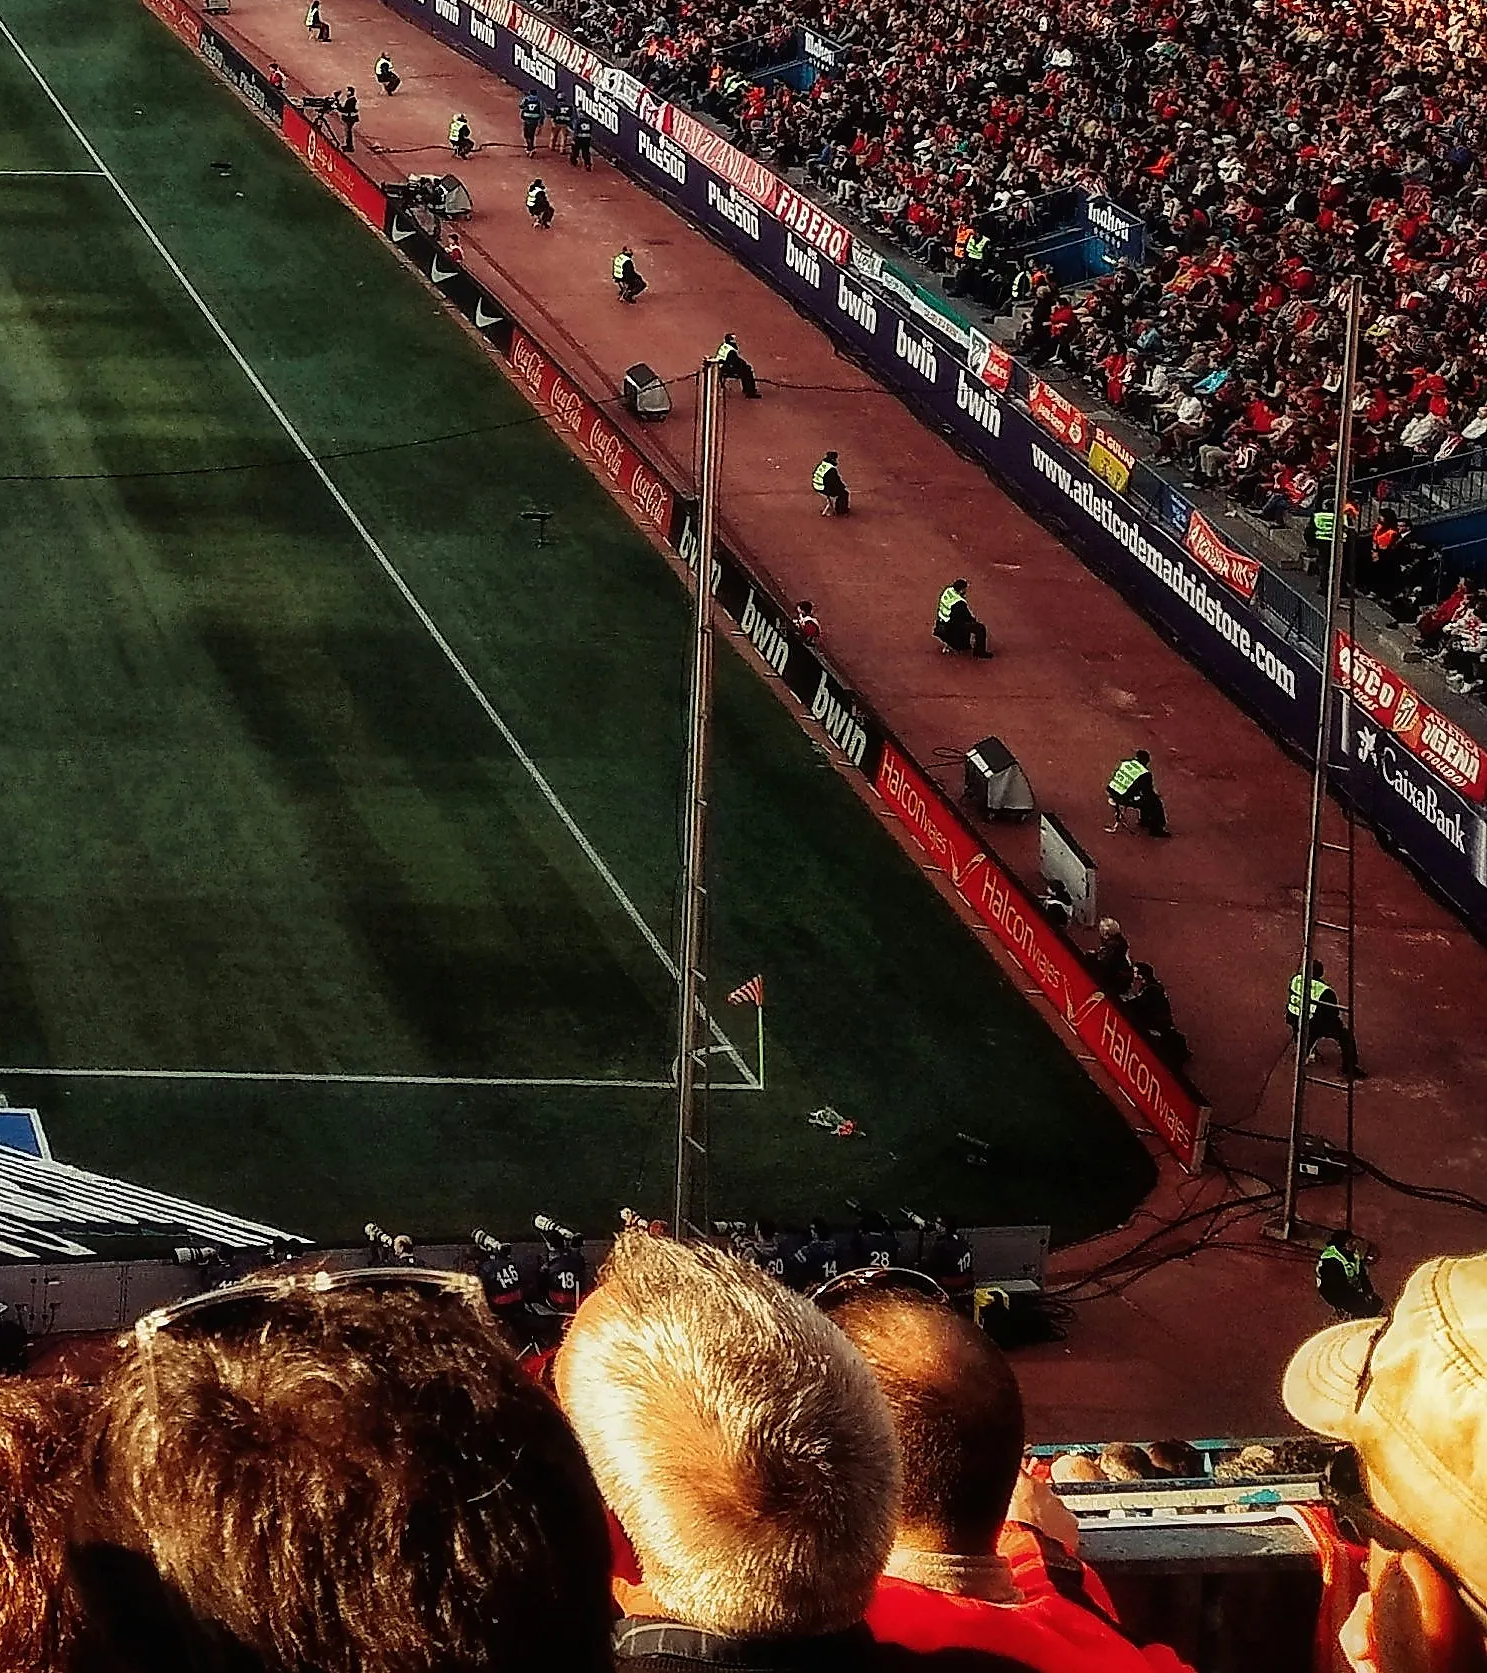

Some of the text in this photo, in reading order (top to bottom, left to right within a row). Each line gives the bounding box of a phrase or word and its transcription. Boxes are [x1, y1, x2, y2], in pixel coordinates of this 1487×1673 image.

[514, 43, 556, 90] Plus500
[575, 85, 618, 134] Plus500
[638, 130, 686, 185] Plus500
[708, 180, 759, 241] Plus500
[776, 189, 842, 259] FABERO
[786, 232, 820, 289] bwin
[838, 274, 877, 335] bwin
[514, 337, 545, 392] Coca-Cola
[896, 320, 937, 384] bwin
[551, 376, 584, 432] Coca-Cola
[956, 369, 1001, 438] bwin
[590, 419, 624, 476] Coca-Cola
[631, 465, 667, 525] Coca-Cola
[1031, 443, 1297, 701] www.atleticodemadridstore.com
[741, 587, 789, 679] bwin
[812, 670, 867, 766] bwin
[1382, 746, 1466, 855] CaixaBank
[496, 1265, 519, 1290] 146
[557, 1271, 575, 1290] 18
[870, 1250, 890, 1268] 28
